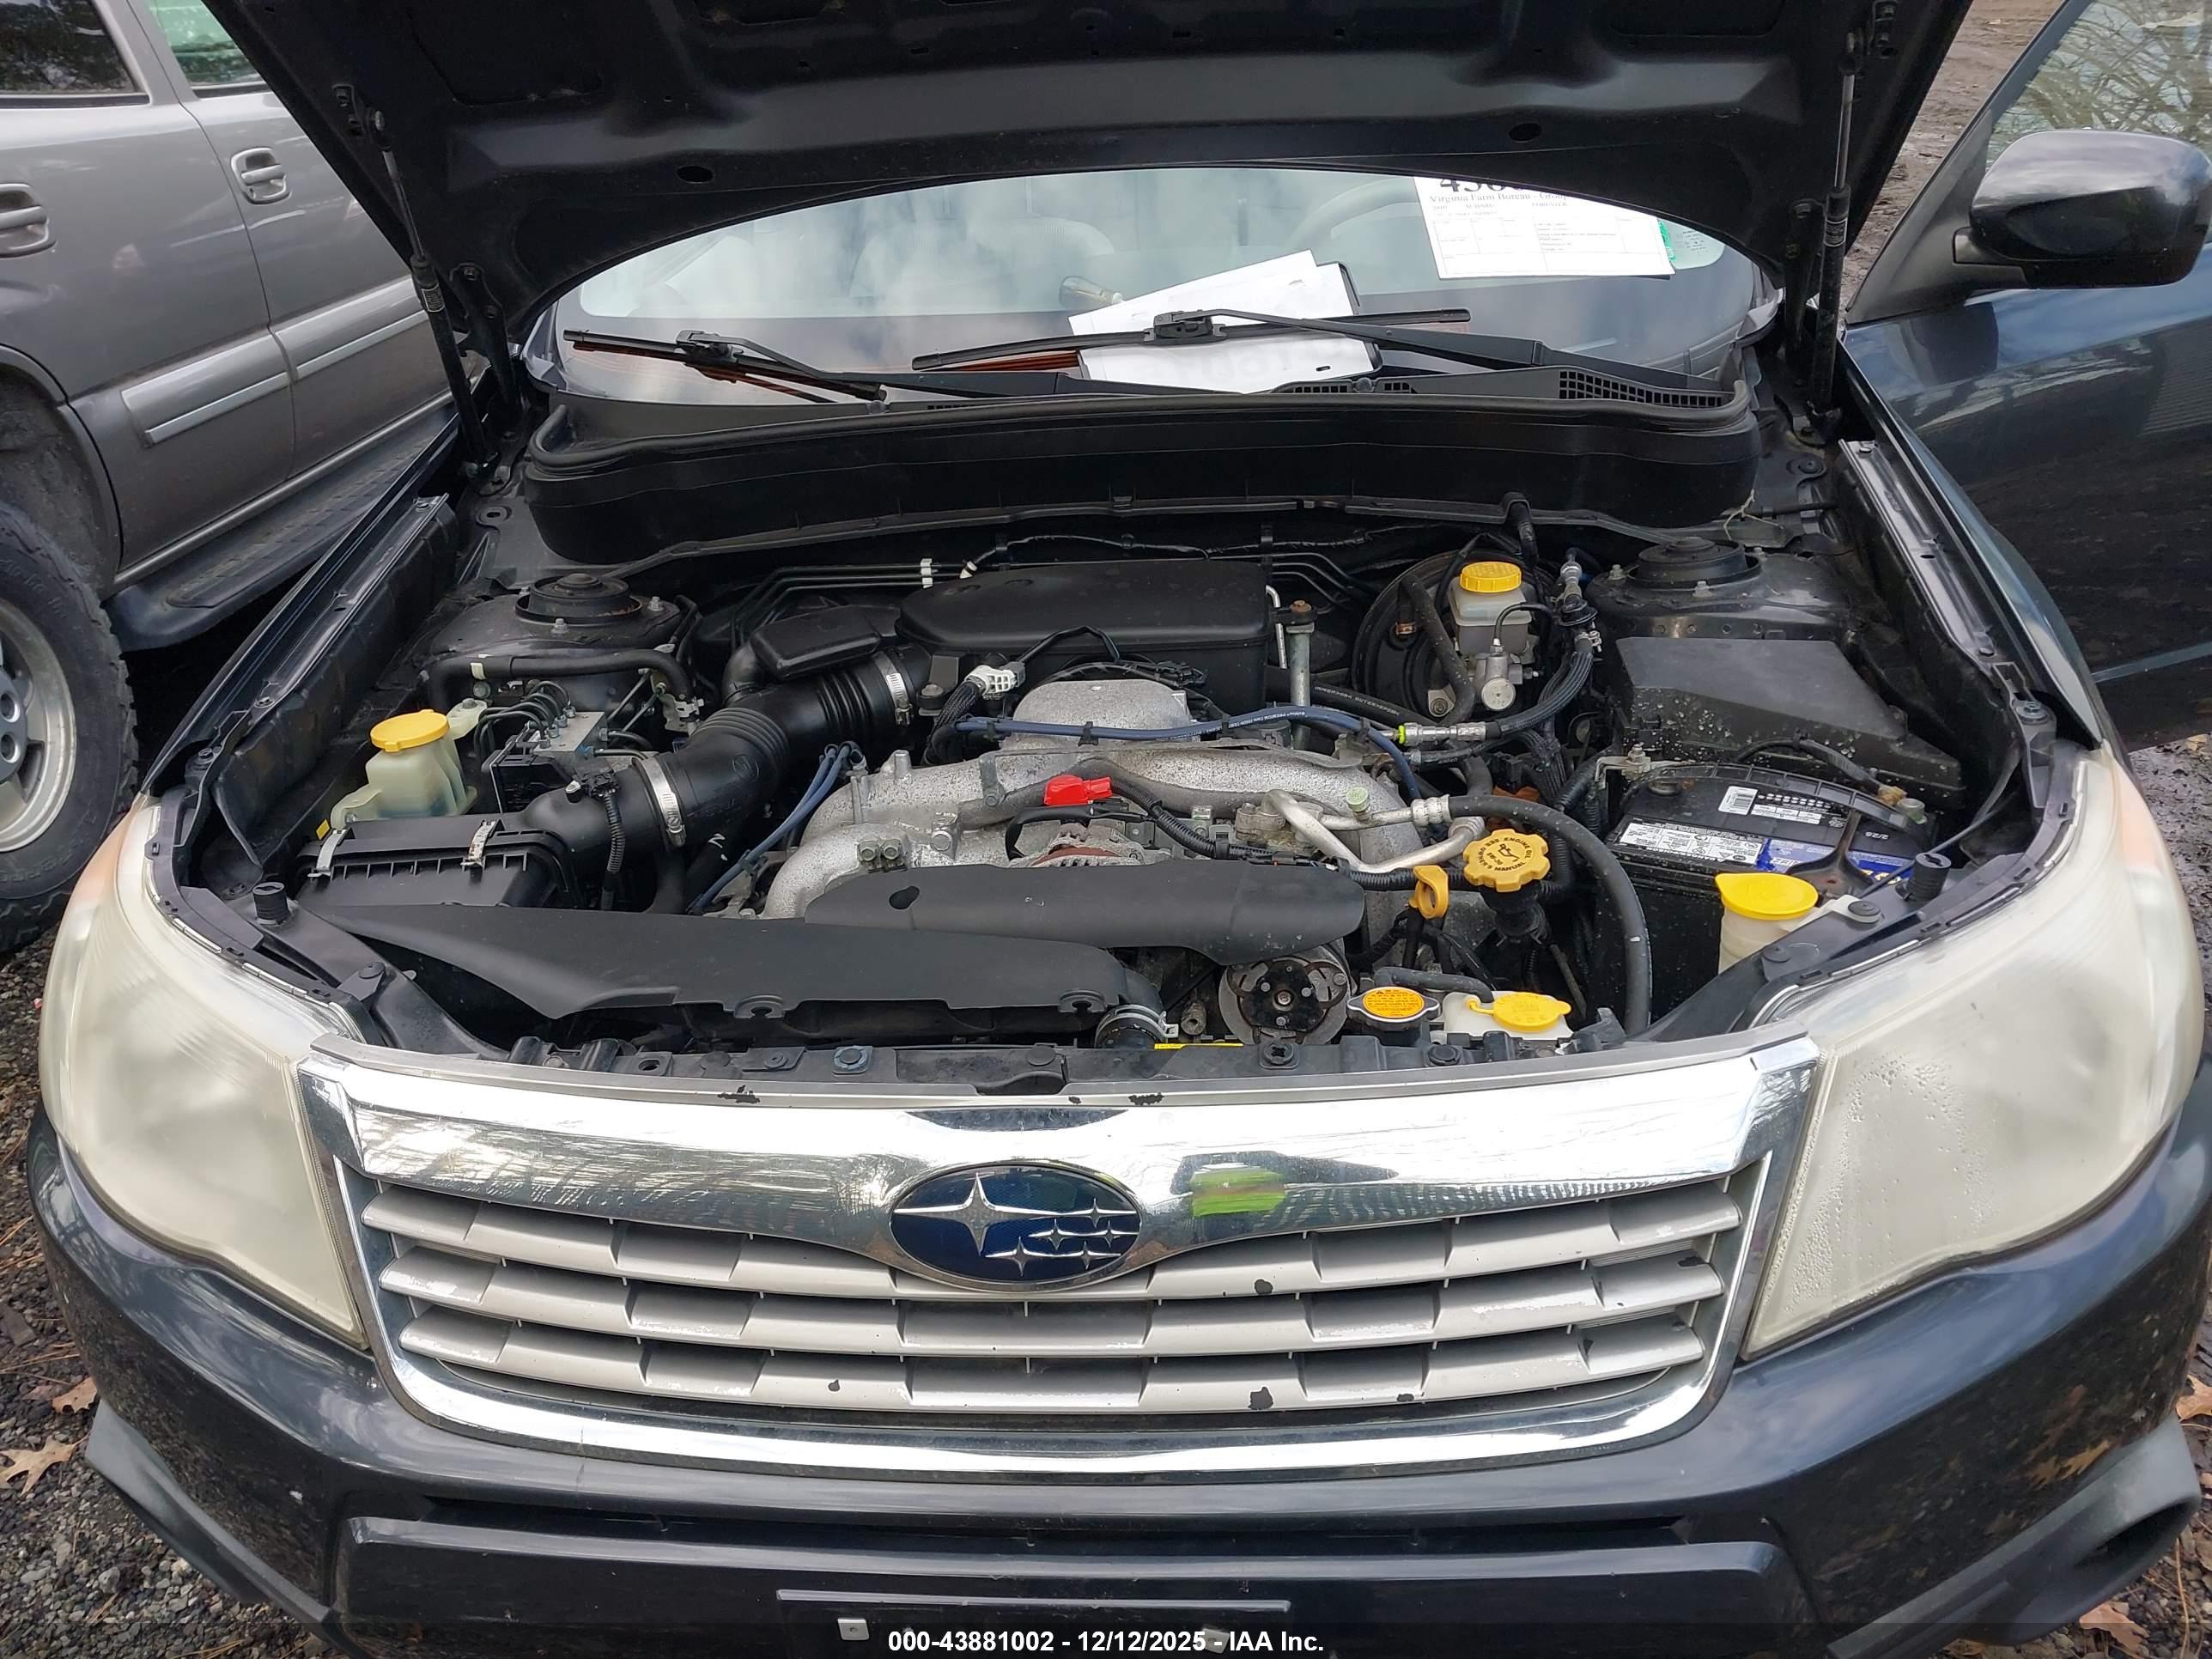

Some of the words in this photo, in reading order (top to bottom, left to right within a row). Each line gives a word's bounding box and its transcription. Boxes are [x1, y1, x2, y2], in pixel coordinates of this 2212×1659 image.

[1429, 194, 1468, 204] Virginia
[1485, 838, 1499, 847] SEE
[1493, 861, 1527, 872] MANUAL
[1504, 836, 1530, 849] ENGINE
[1524, 849, 1533, 859] OIL
